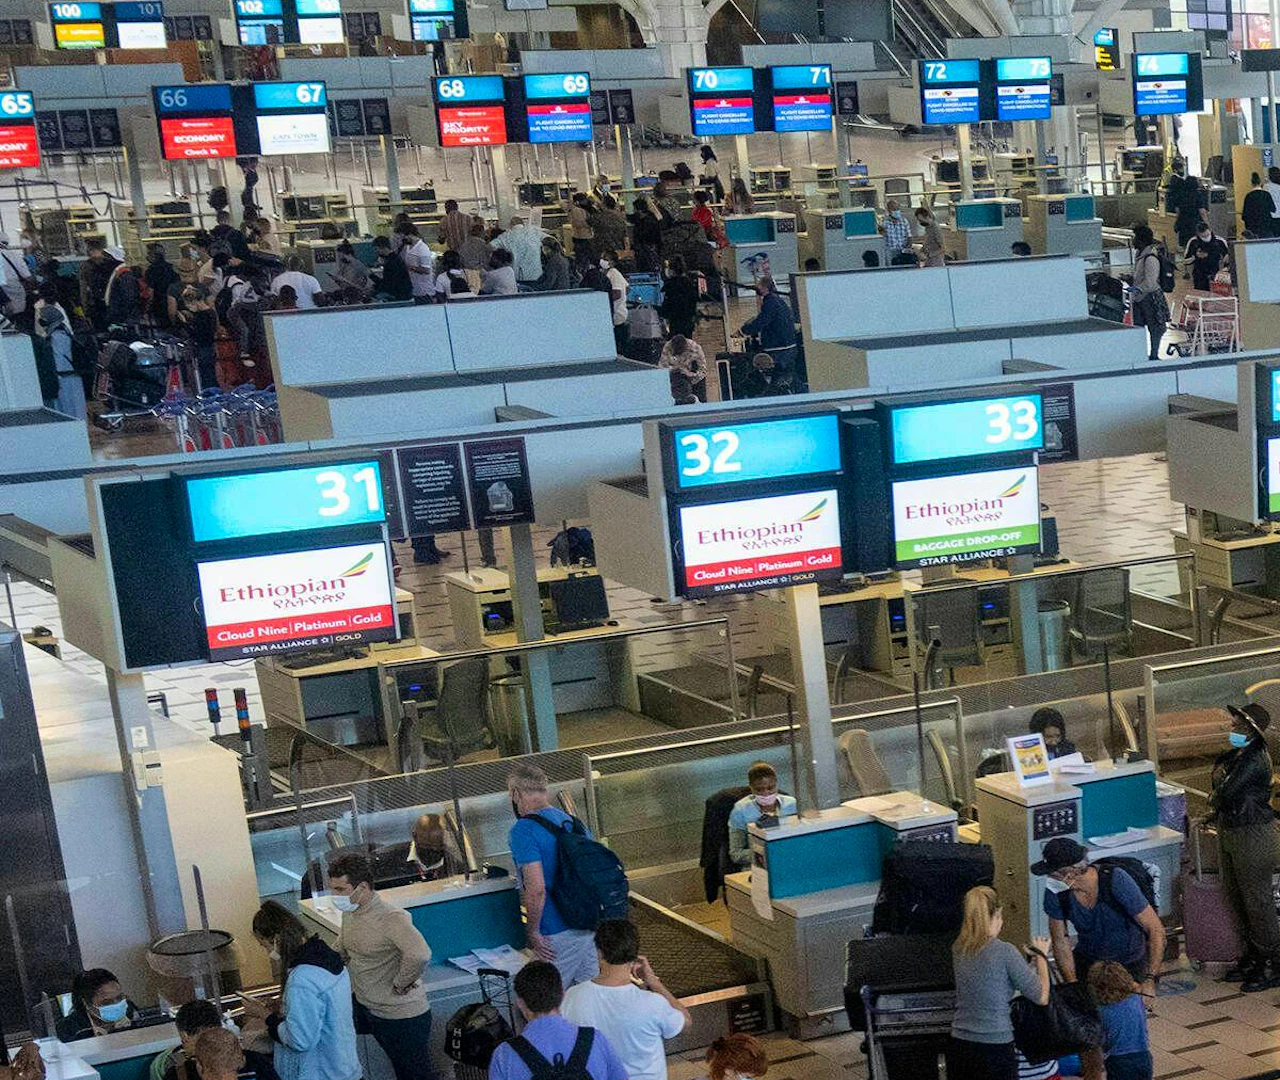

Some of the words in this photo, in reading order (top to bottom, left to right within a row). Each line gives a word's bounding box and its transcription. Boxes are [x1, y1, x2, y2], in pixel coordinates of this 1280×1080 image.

[54, 5, 81, 17] 100
[238, 1, 264, 14] 102
[810, 67, 830, 84] 71
[925, 63, 947, 80] 72
[1029, 60, 1050, 76] 73
[562, 75, 588, 93] 69
[694, 70, 718, 89] 70
[160, 89, 188, 107] 66
[295, 84, 323, 103] 67
[439, 80, 466, 98] 68
[1, 94, 32, 114] 65
[173, 133, 225, 143] ECONOMY
[443, 126, 489, 134] PRIORITY
[985, 400, 1038, 445] 33
[681, 431, 742, 477] 32
[315, 467, 381, 517] 31
[906, 498, 1002, 519] Ethiopian
[698, 521, 803, 544] Ethiopian
[914, 540, 964, 552] BAGGAGE
[966, 532, 1021, 546] DROP-OFF
[920, 557, 948, 566] STAR
[951, 549, 1004, 562] ALLIANCE
[694, 569, 725, 580] Cloud
[728, 565, 753, 575] Nine
[759, 560, 802, 572] Platinum
[808, 555, 832, 564] Gold
[220, 577, 346, 603] Ethiopian
[738, 579, 778, 588] ALLIANCE
[218, 628, 254, 641] Cloud
[258, 625, 287, 636] Nine
[295, 619, 346, 631] Platinum
[353, 614, 381, 624] Gold
[270, 639, 318, 650] ALLIANCE
[336, 633, 361, 642] GOLD
